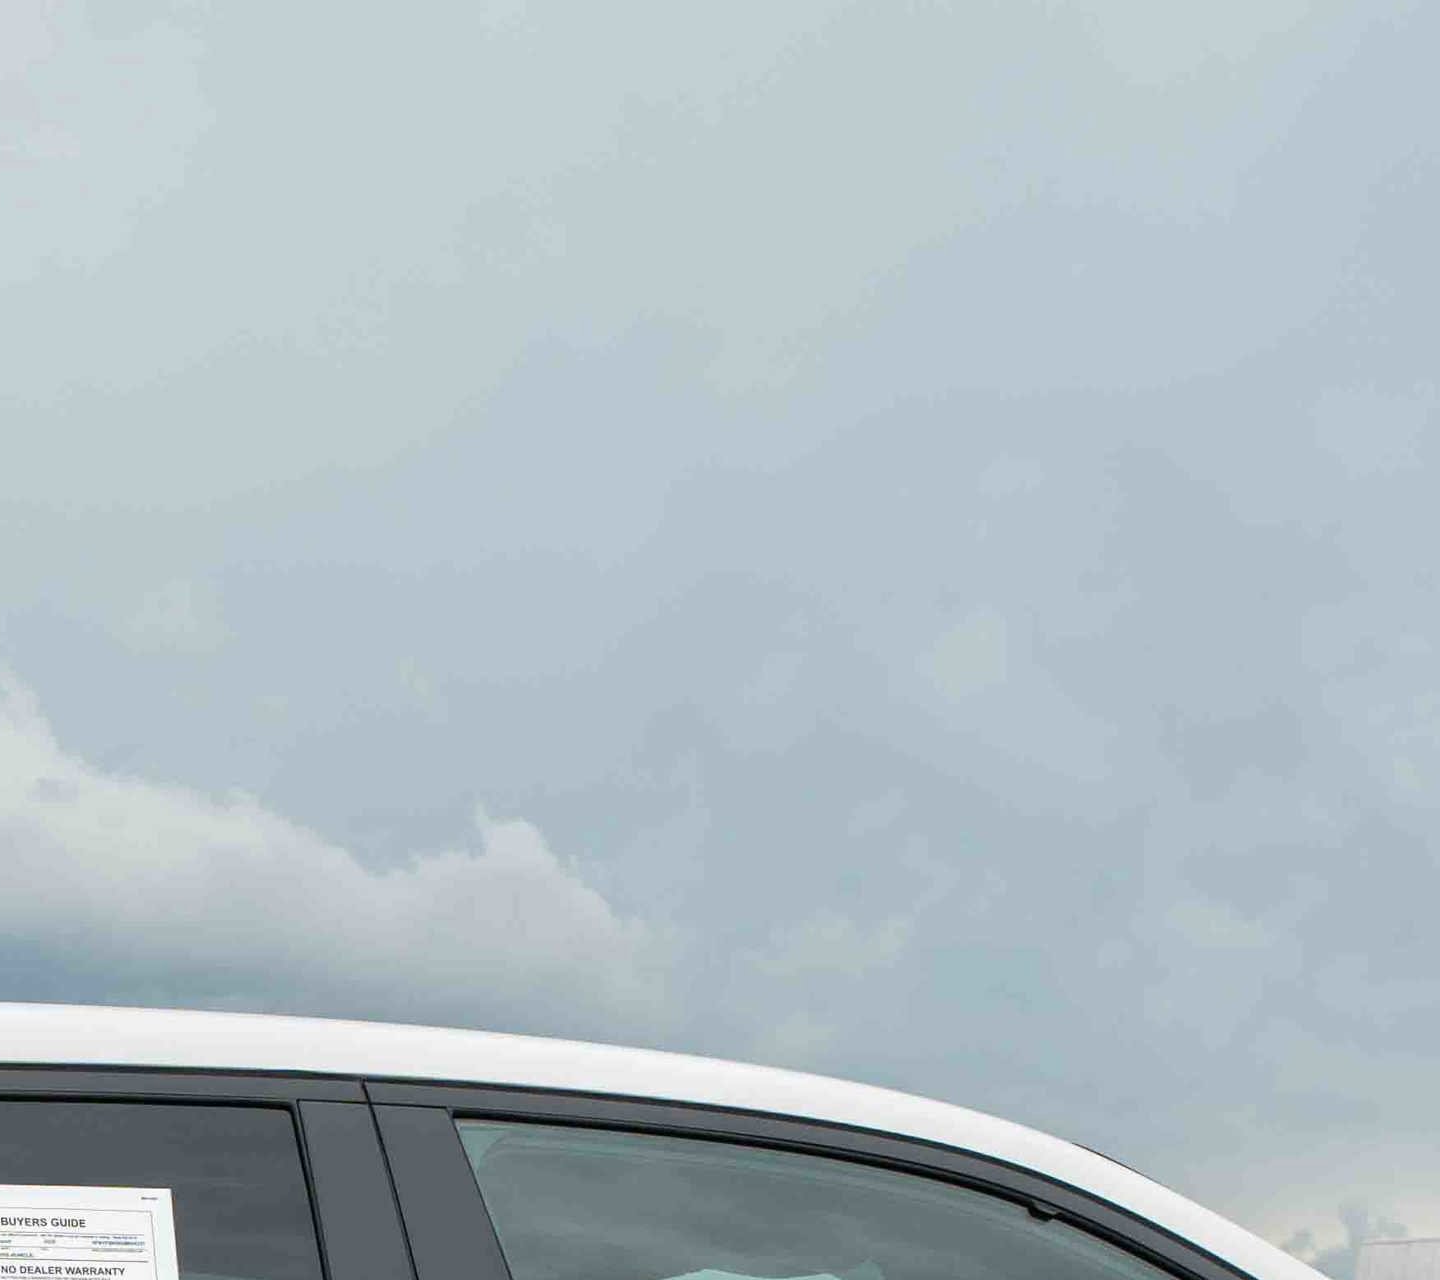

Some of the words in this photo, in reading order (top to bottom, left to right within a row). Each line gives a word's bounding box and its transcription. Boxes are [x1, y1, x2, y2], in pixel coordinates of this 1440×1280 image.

[0, 1216, 48, 1227] BUYERS
[50, 1217, 87, 1228] GUIDE
[1, 1265, 17, 1274] NO
[19, 1266, 63, 1275] DEALER
[65, 1267, 126, 1276] WARRANTY
